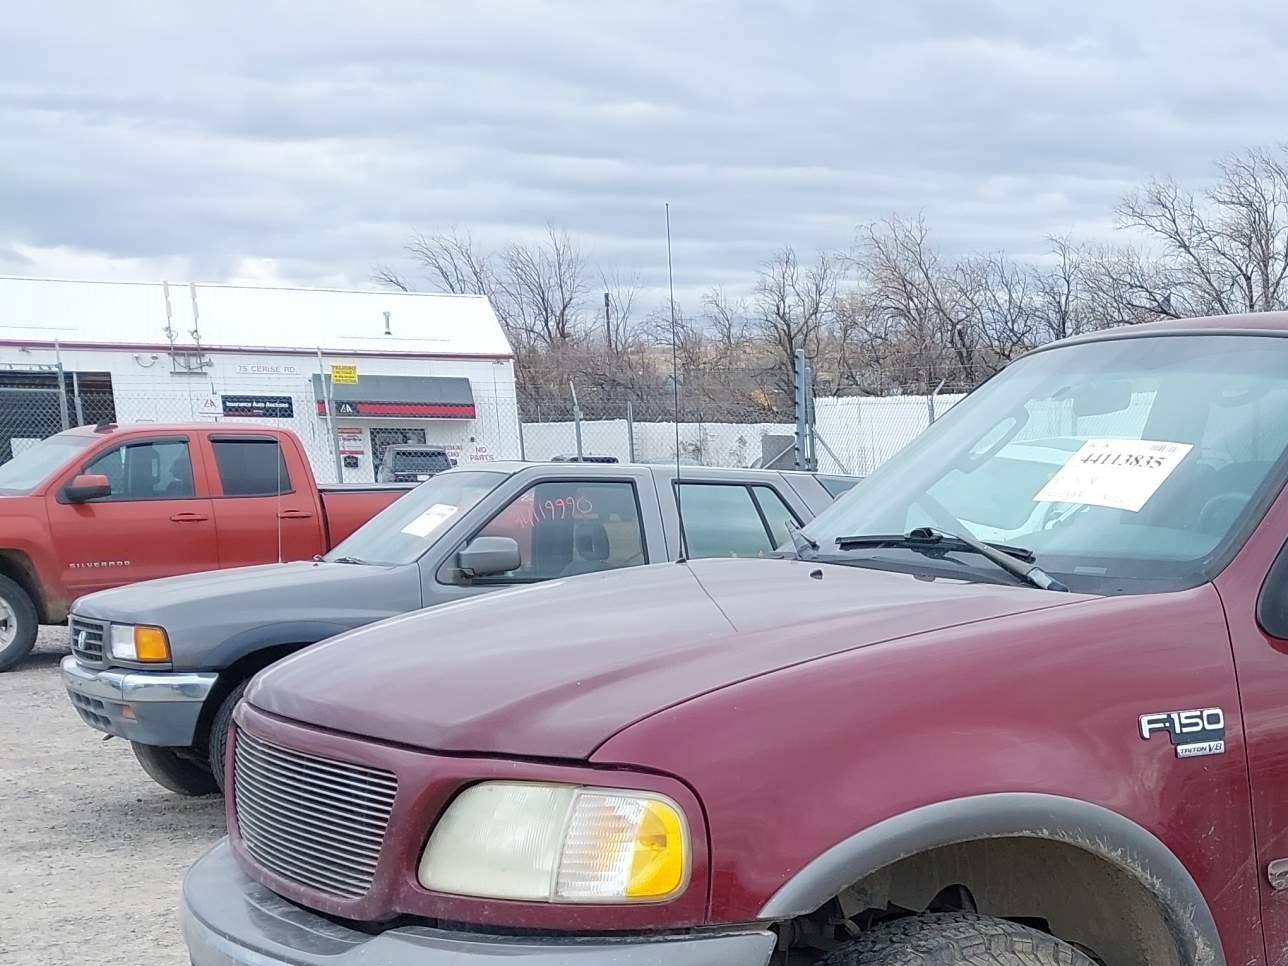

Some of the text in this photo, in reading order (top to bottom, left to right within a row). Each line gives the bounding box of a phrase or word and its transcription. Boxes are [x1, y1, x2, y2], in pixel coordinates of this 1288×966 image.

[475, 446, 487, 454] NO
[1080, 453, 1167, 469] 44113835
[68, 560, 131, 569] SILVERADO
[1180, 742, 1222, 754] TRITON V8
